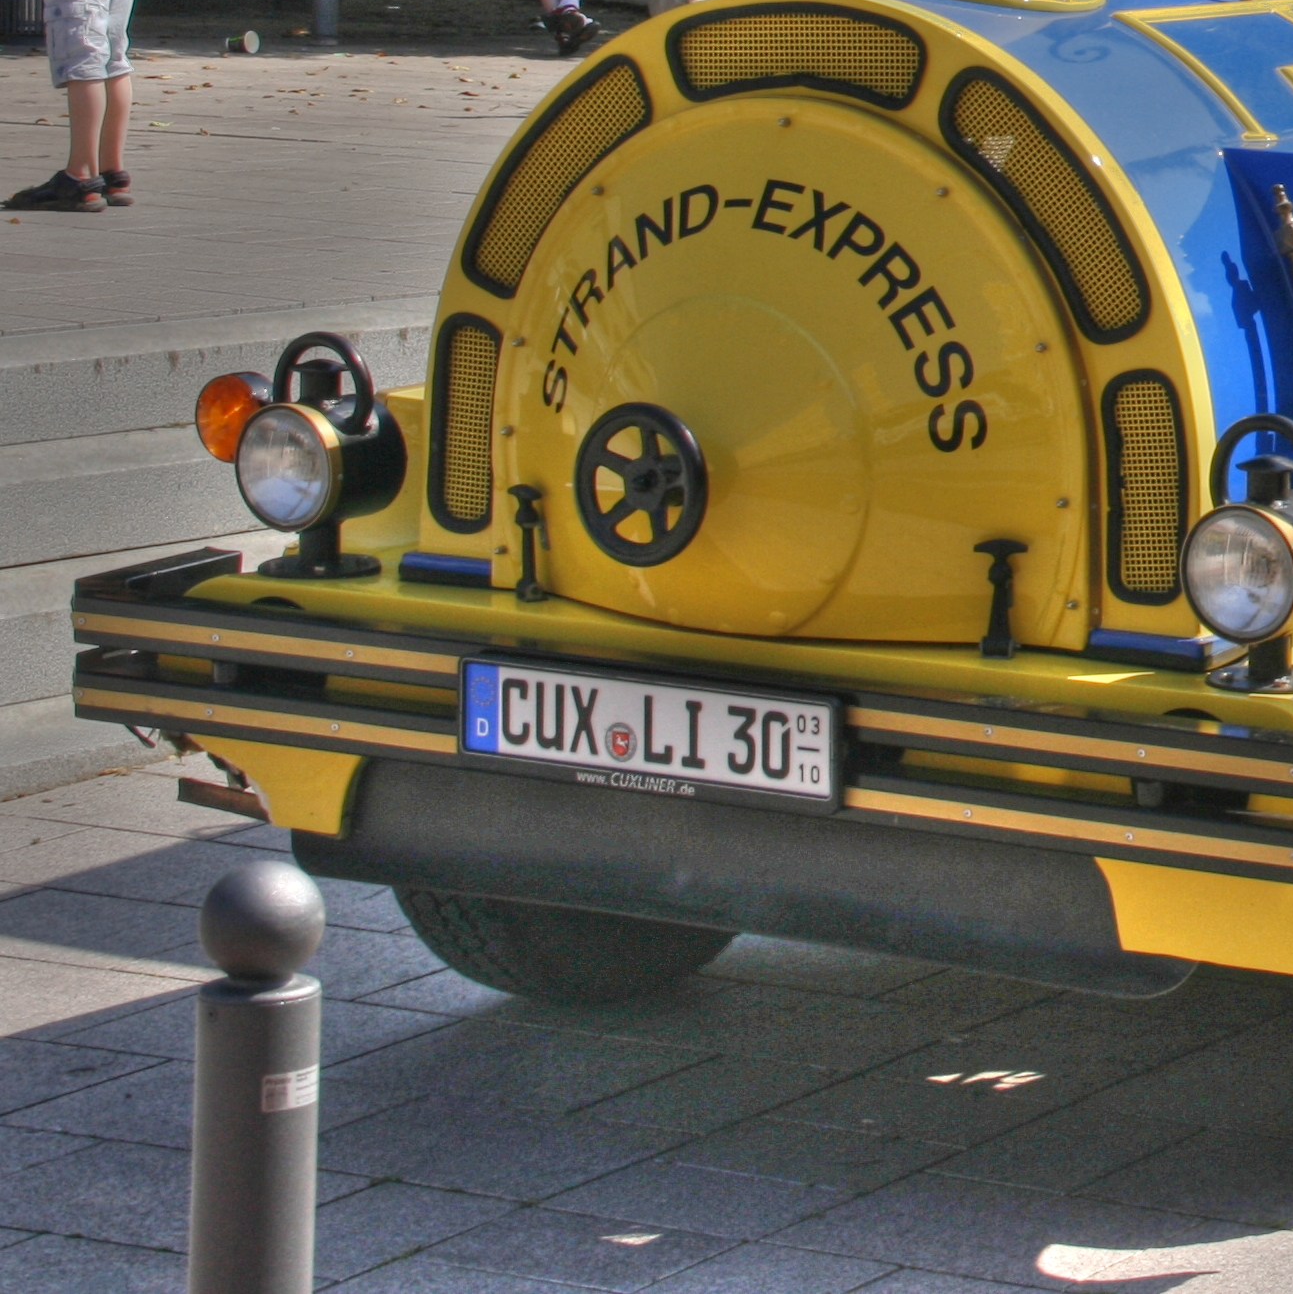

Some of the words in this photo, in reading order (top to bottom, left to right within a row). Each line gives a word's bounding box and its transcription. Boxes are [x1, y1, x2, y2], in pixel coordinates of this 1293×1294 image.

[542, 178, 988, 454] STRAND-EXPRESS
[476, 717, 489, 738] D
[501, 677, 600, 755] CUX
[643, 694, 706, 770] LI
[726, 704, 792, 780] 30
[796, 714, 821, 735] 03
[798, 763, 821, 784] 10
